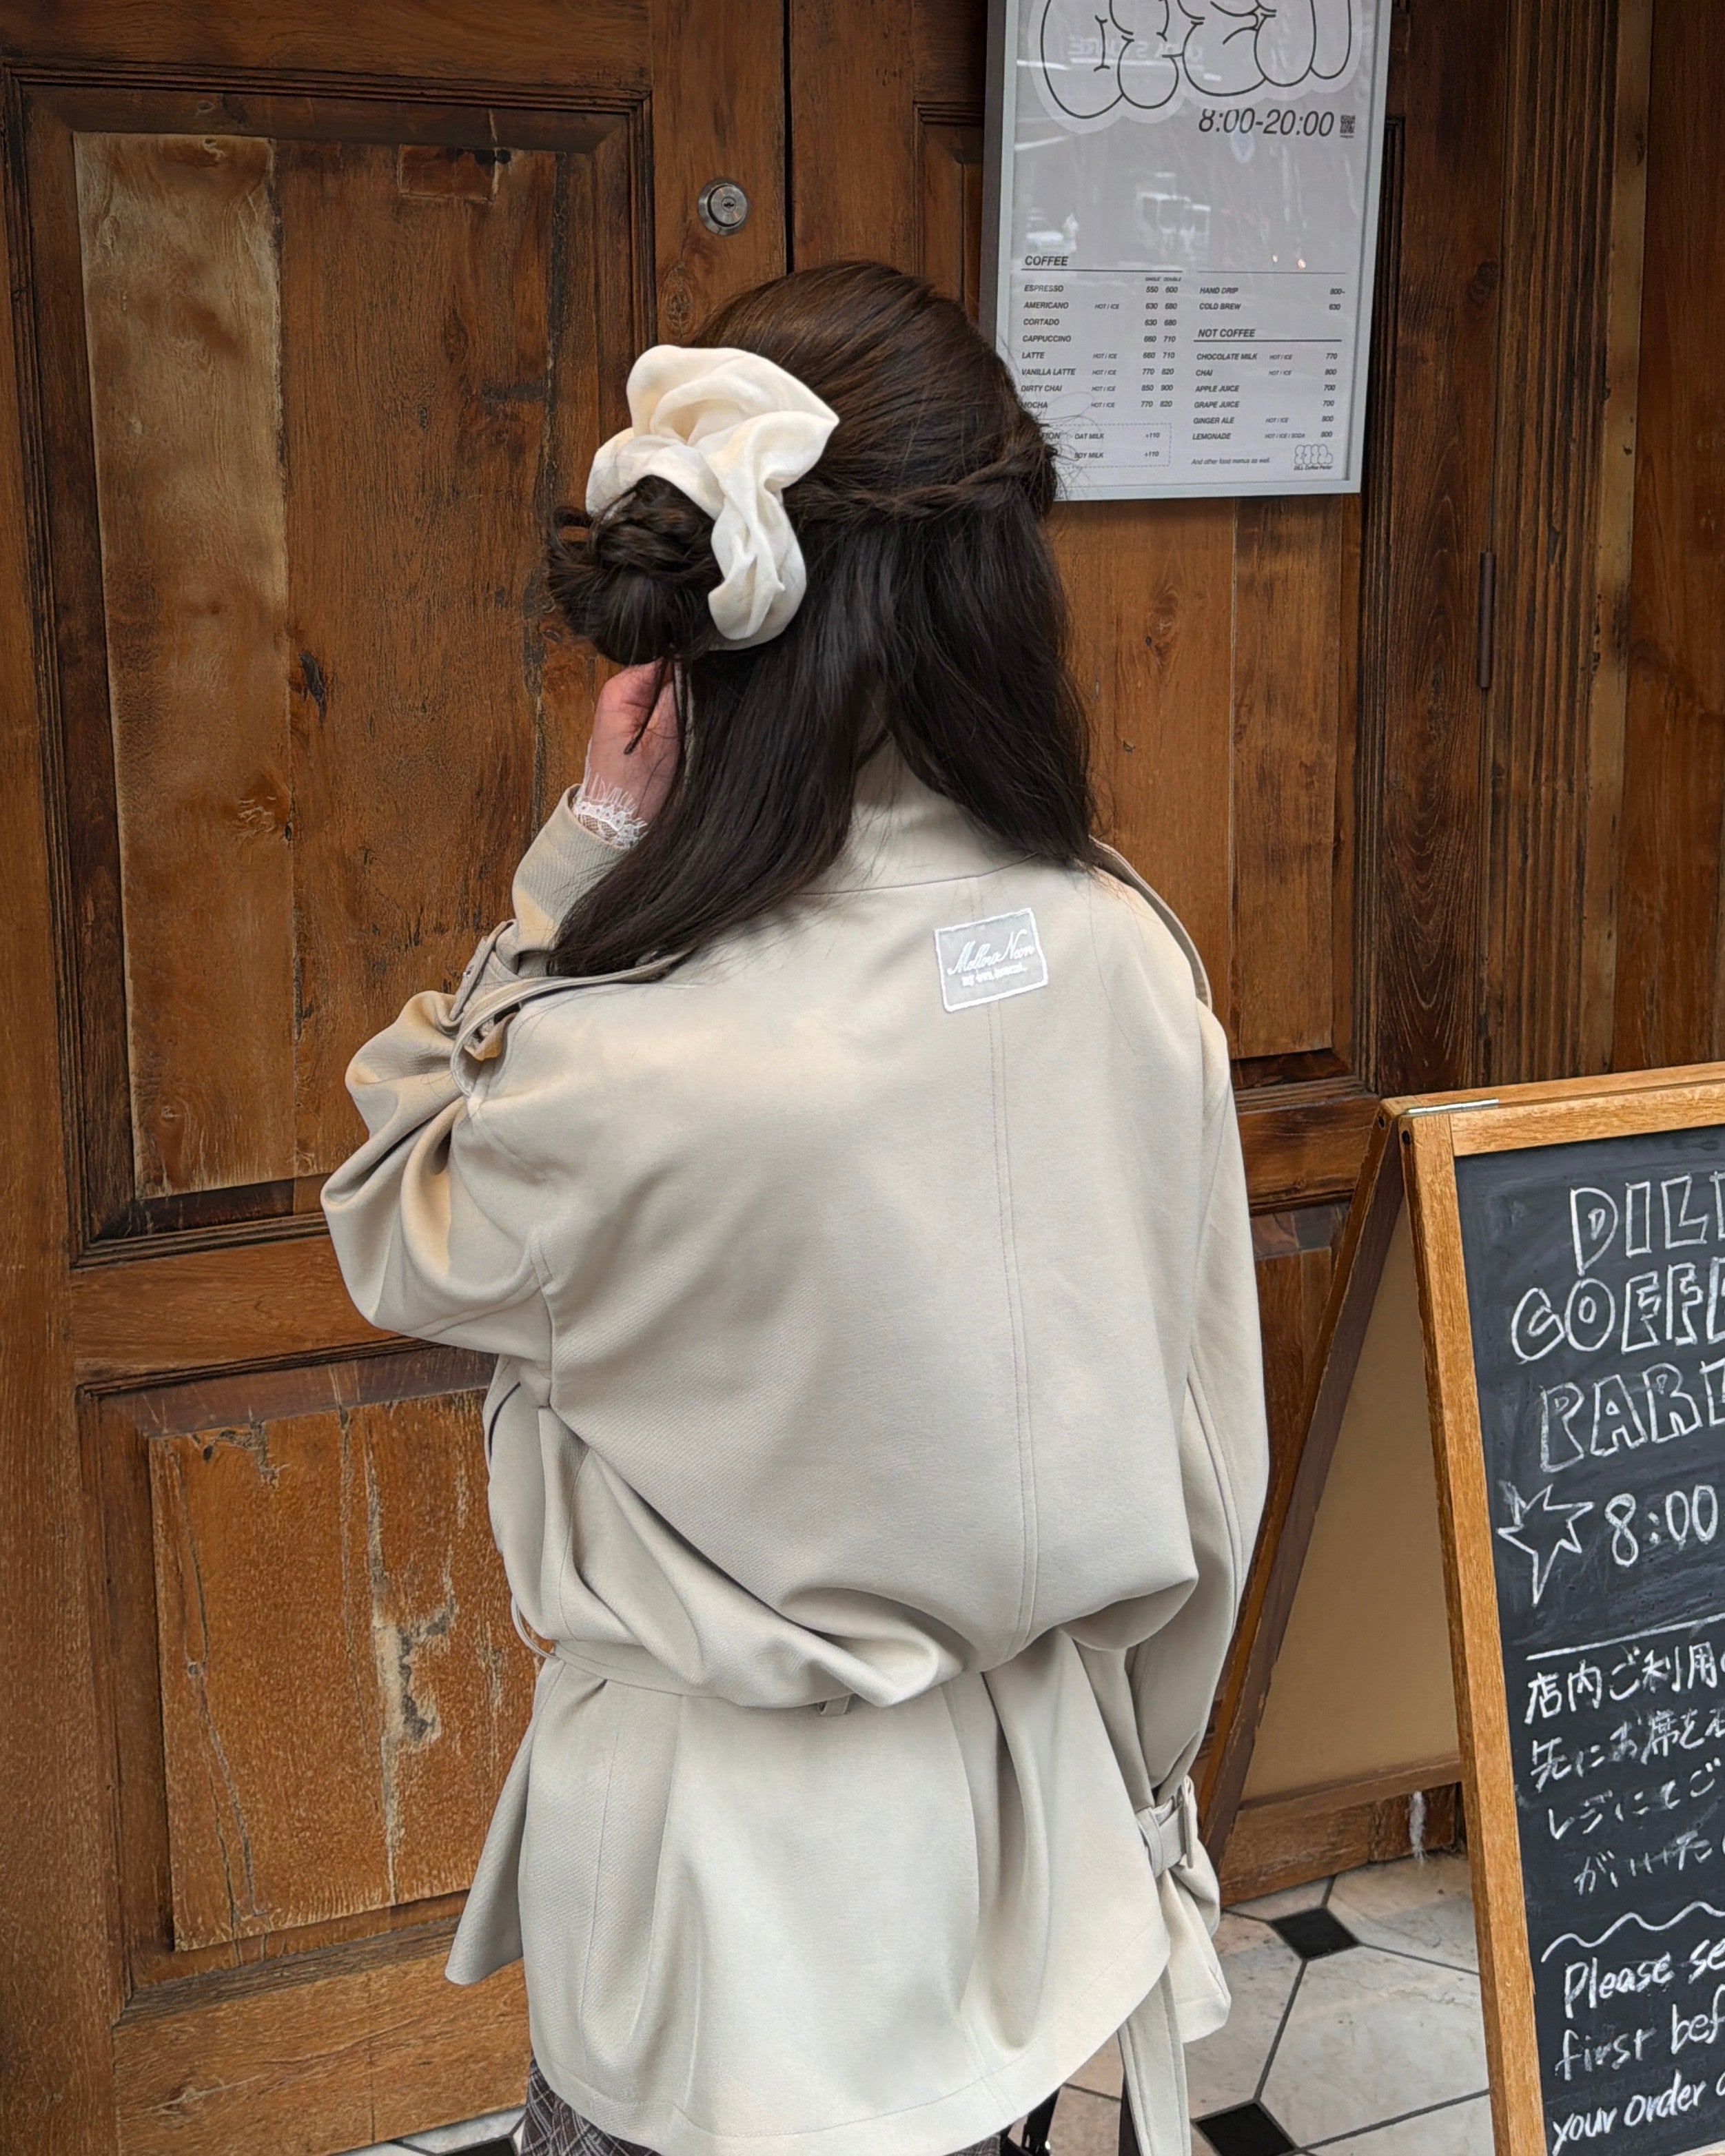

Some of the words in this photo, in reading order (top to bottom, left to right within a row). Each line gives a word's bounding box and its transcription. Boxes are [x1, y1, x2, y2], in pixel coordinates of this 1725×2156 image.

[1199, 108, 1334, 136] 8:00-20:00
[1025, 256, 1069, 266] COFFEE
[1198, 329, 1218, 338] NOT
[1220, 329, 1256, 338] COFFEE
[1605, 1483, 1719, 1568] 8:00
[1524, 1641, 1725, 1724] 店内ご利用
[1564, 1951, 1675, 2020] Please
[1552, 2107, 1617, 2156] your
